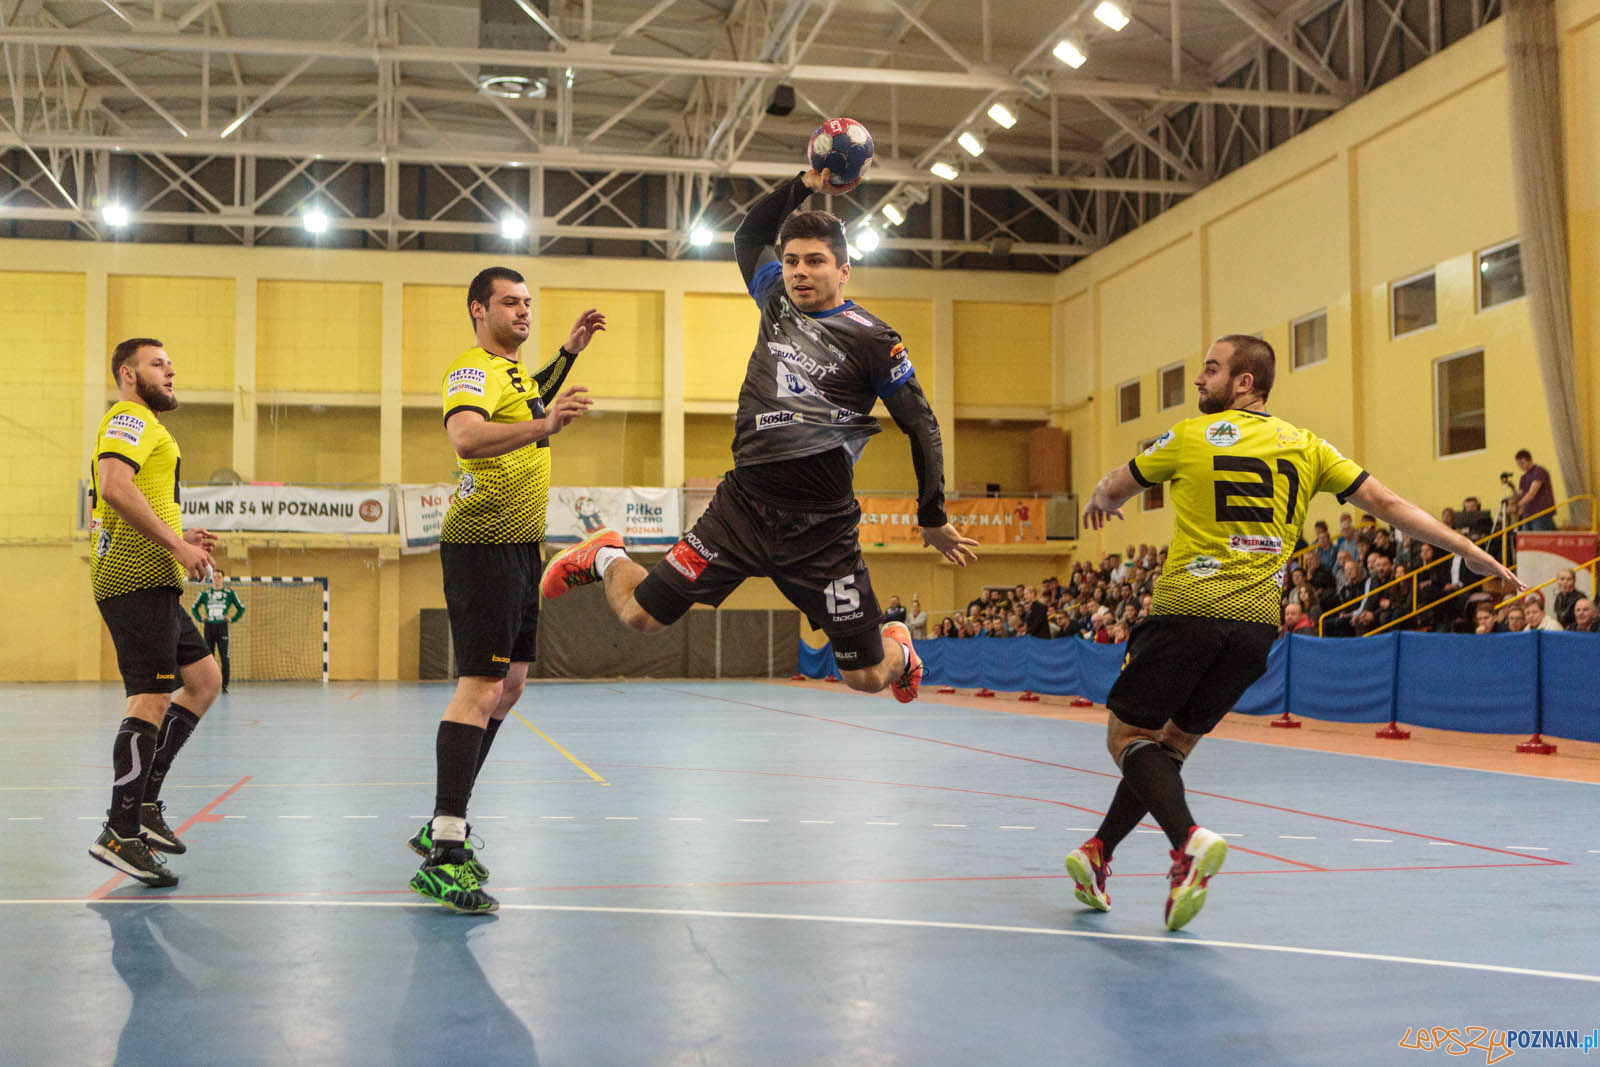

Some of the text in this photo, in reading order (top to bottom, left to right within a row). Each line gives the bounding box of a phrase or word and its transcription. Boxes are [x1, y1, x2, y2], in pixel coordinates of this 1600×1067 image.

[759, 411, 795, 425] isostar
[1213, 455, 1299, 525] 21
[181, 501, 353, 518] JUM NR 54 W POZNANIU
[420, 495, 443, 509] Na
[626, 503, 663, 517] Piłka
[824, 574, 860, 614] 15
